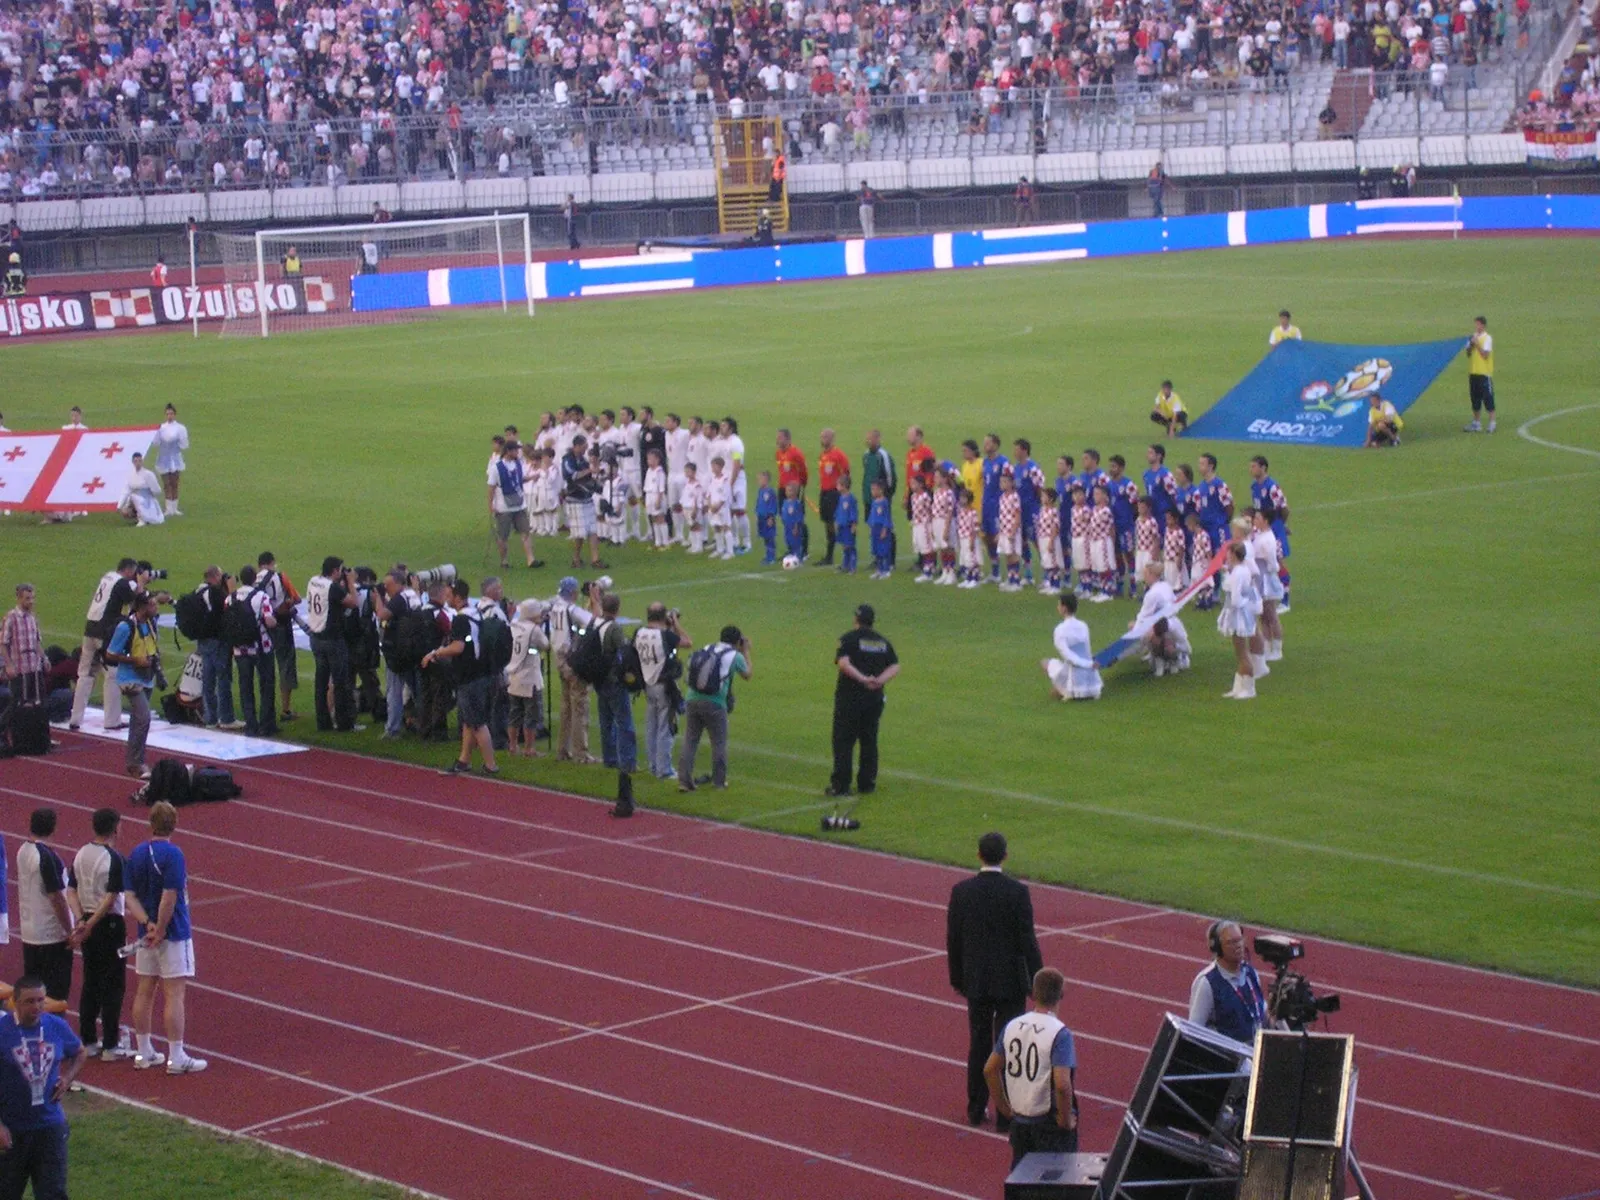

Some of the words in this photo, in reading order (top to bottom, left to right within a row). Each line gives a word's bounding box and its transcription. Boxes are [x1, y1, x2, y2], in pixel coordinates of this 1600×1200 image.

[162, 281, 297, 321] Ožujsko
[1018, 1021, 1046, 1035] TV
[1007, 1037, 1039, 1082] 30
